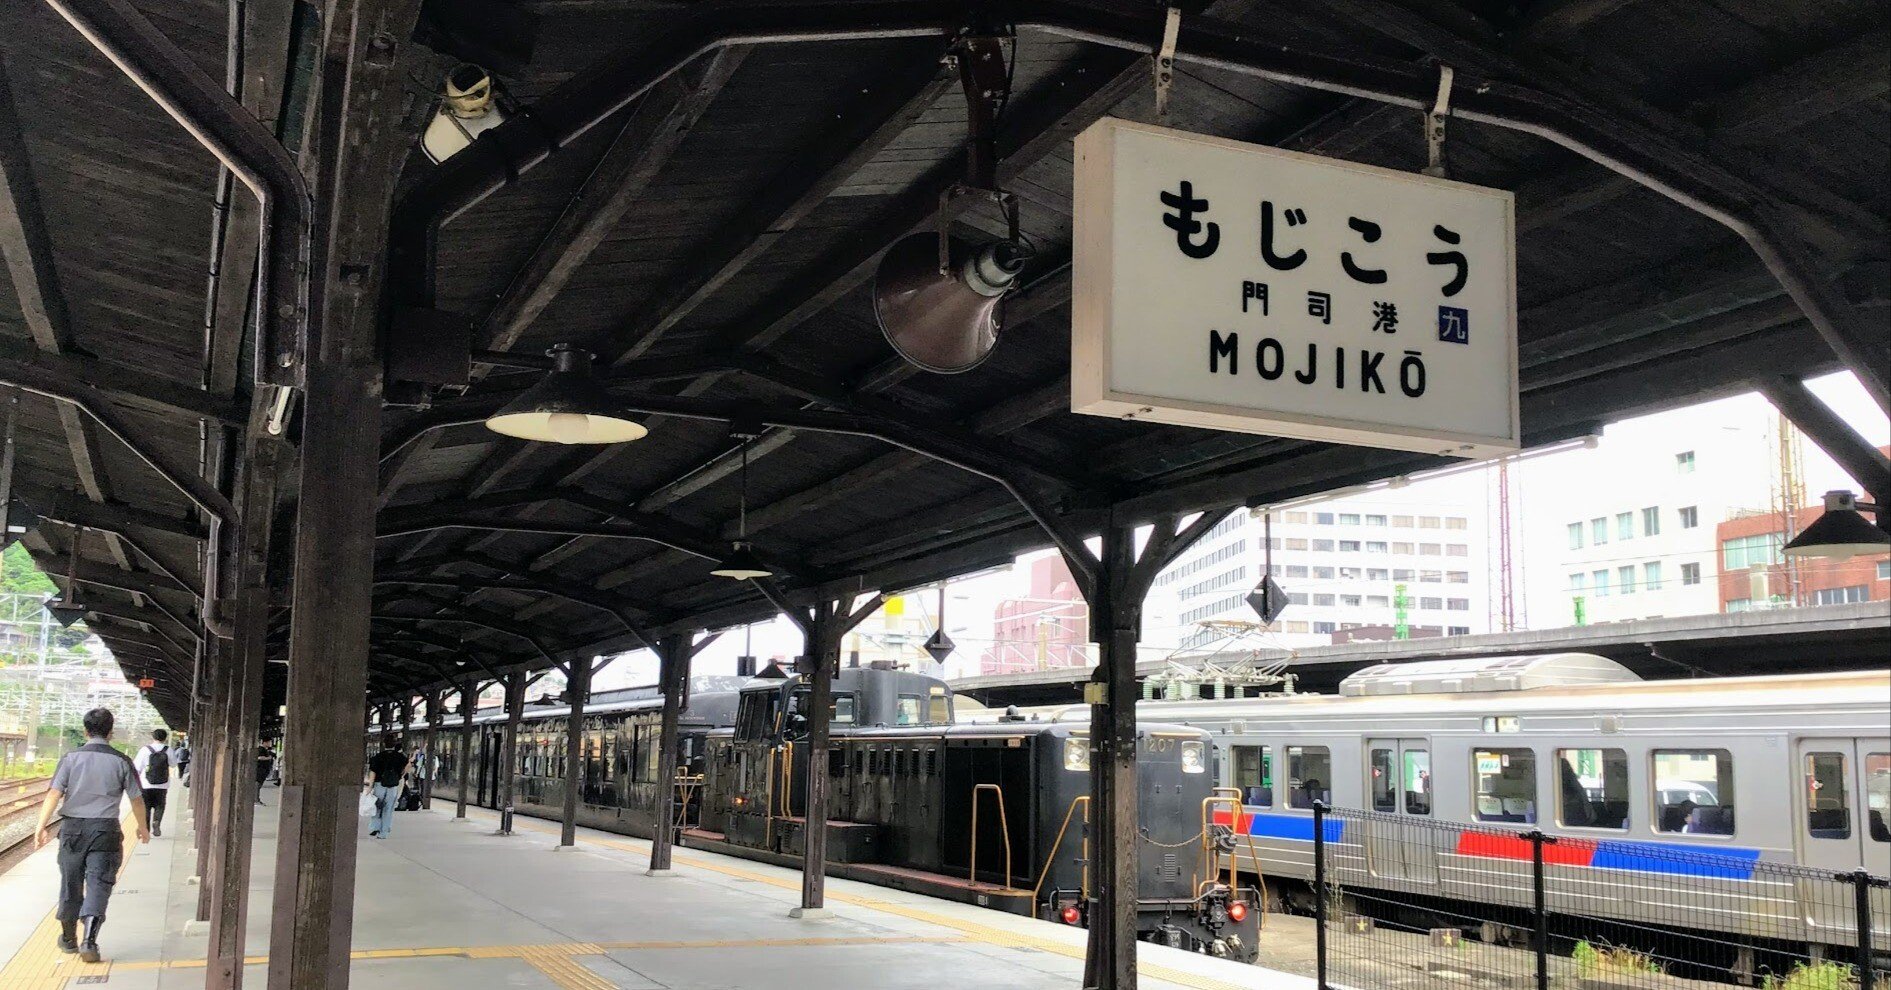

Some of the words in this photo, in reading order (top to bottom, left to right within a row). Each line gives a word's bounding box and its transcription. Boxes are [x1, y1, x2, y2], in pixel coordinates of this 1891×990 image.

[1160, 180, 1469, 298] もじこう
[1242, 280, 1399, 335] 門司港
[1440, 309, 1468, 342] 九
[1210, 329, 1426, 399] MOJIKŌ
